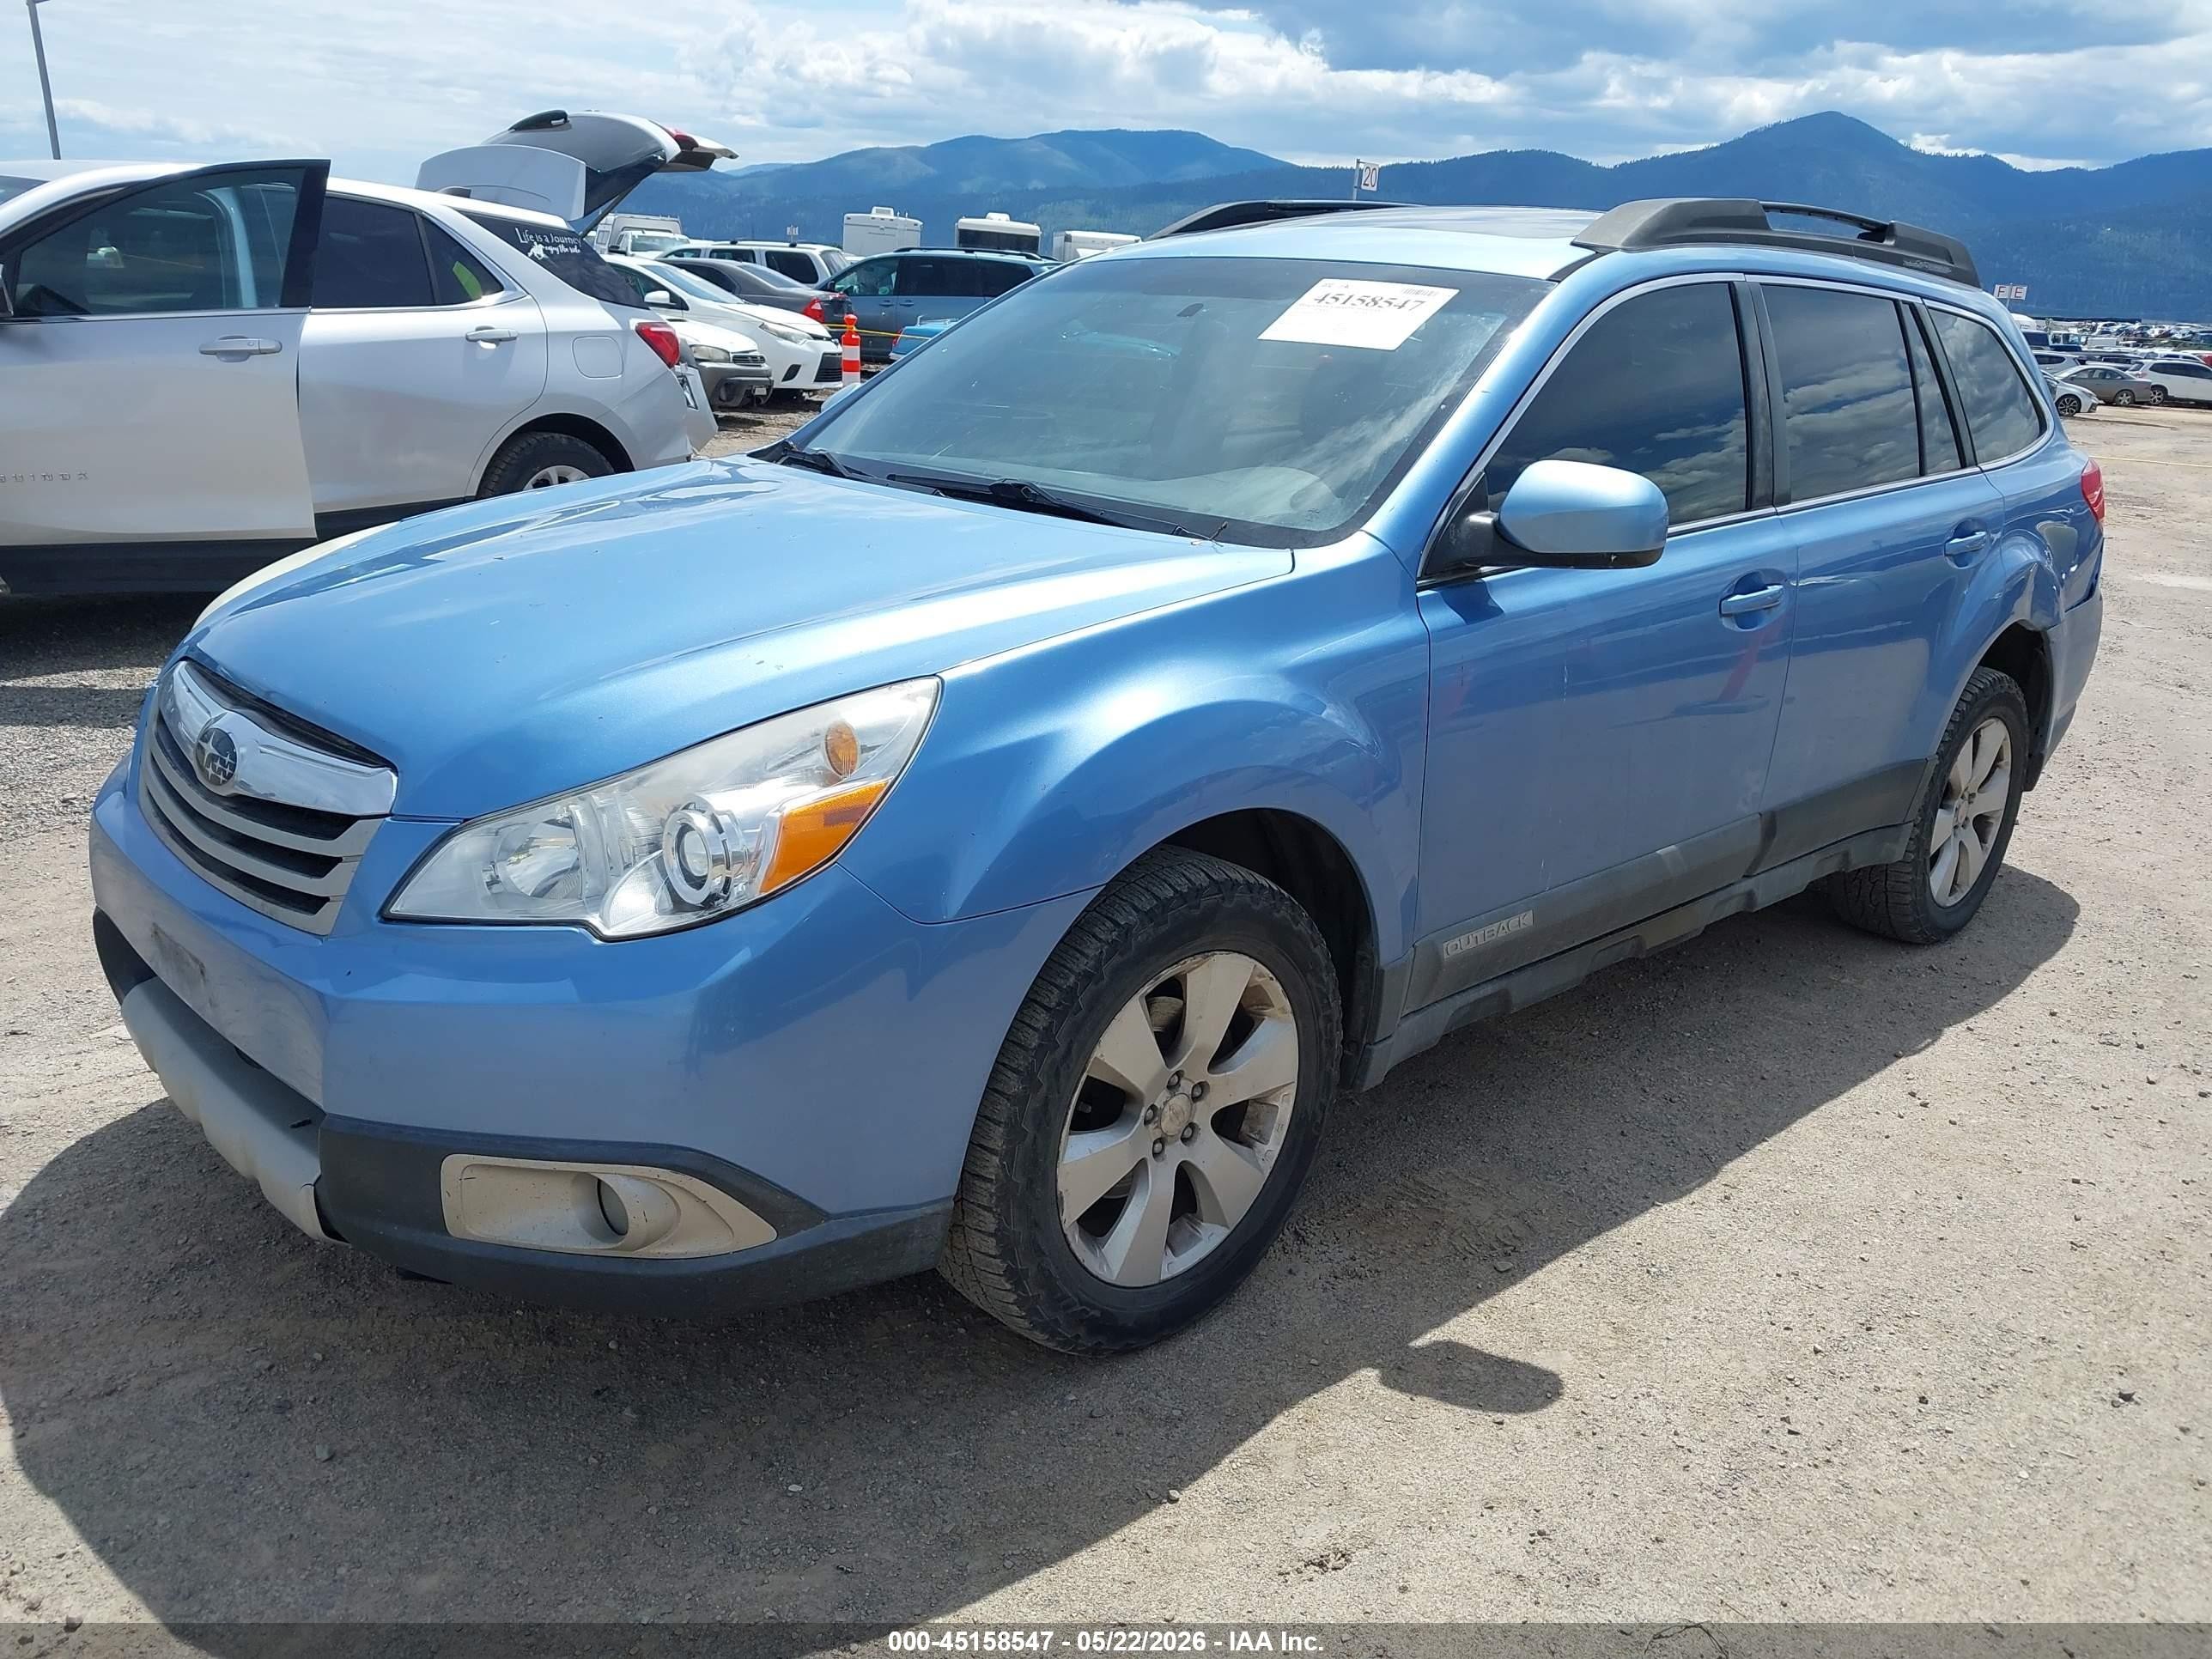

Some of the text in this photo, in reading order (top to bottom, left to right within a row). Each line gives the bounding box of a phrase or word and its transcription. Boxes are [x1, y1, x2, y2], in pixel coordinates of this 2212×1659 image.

[1363, 167, 1377, 187] 20
[515, 228, 581, 247] Life is a Journey
[1997, 286, 2006, 297] F
[2014, 287, 2023, 298] E
[1314, 293, 1427, 312] 45158547
[1445, 912, 1530, 957] OUTBACK
